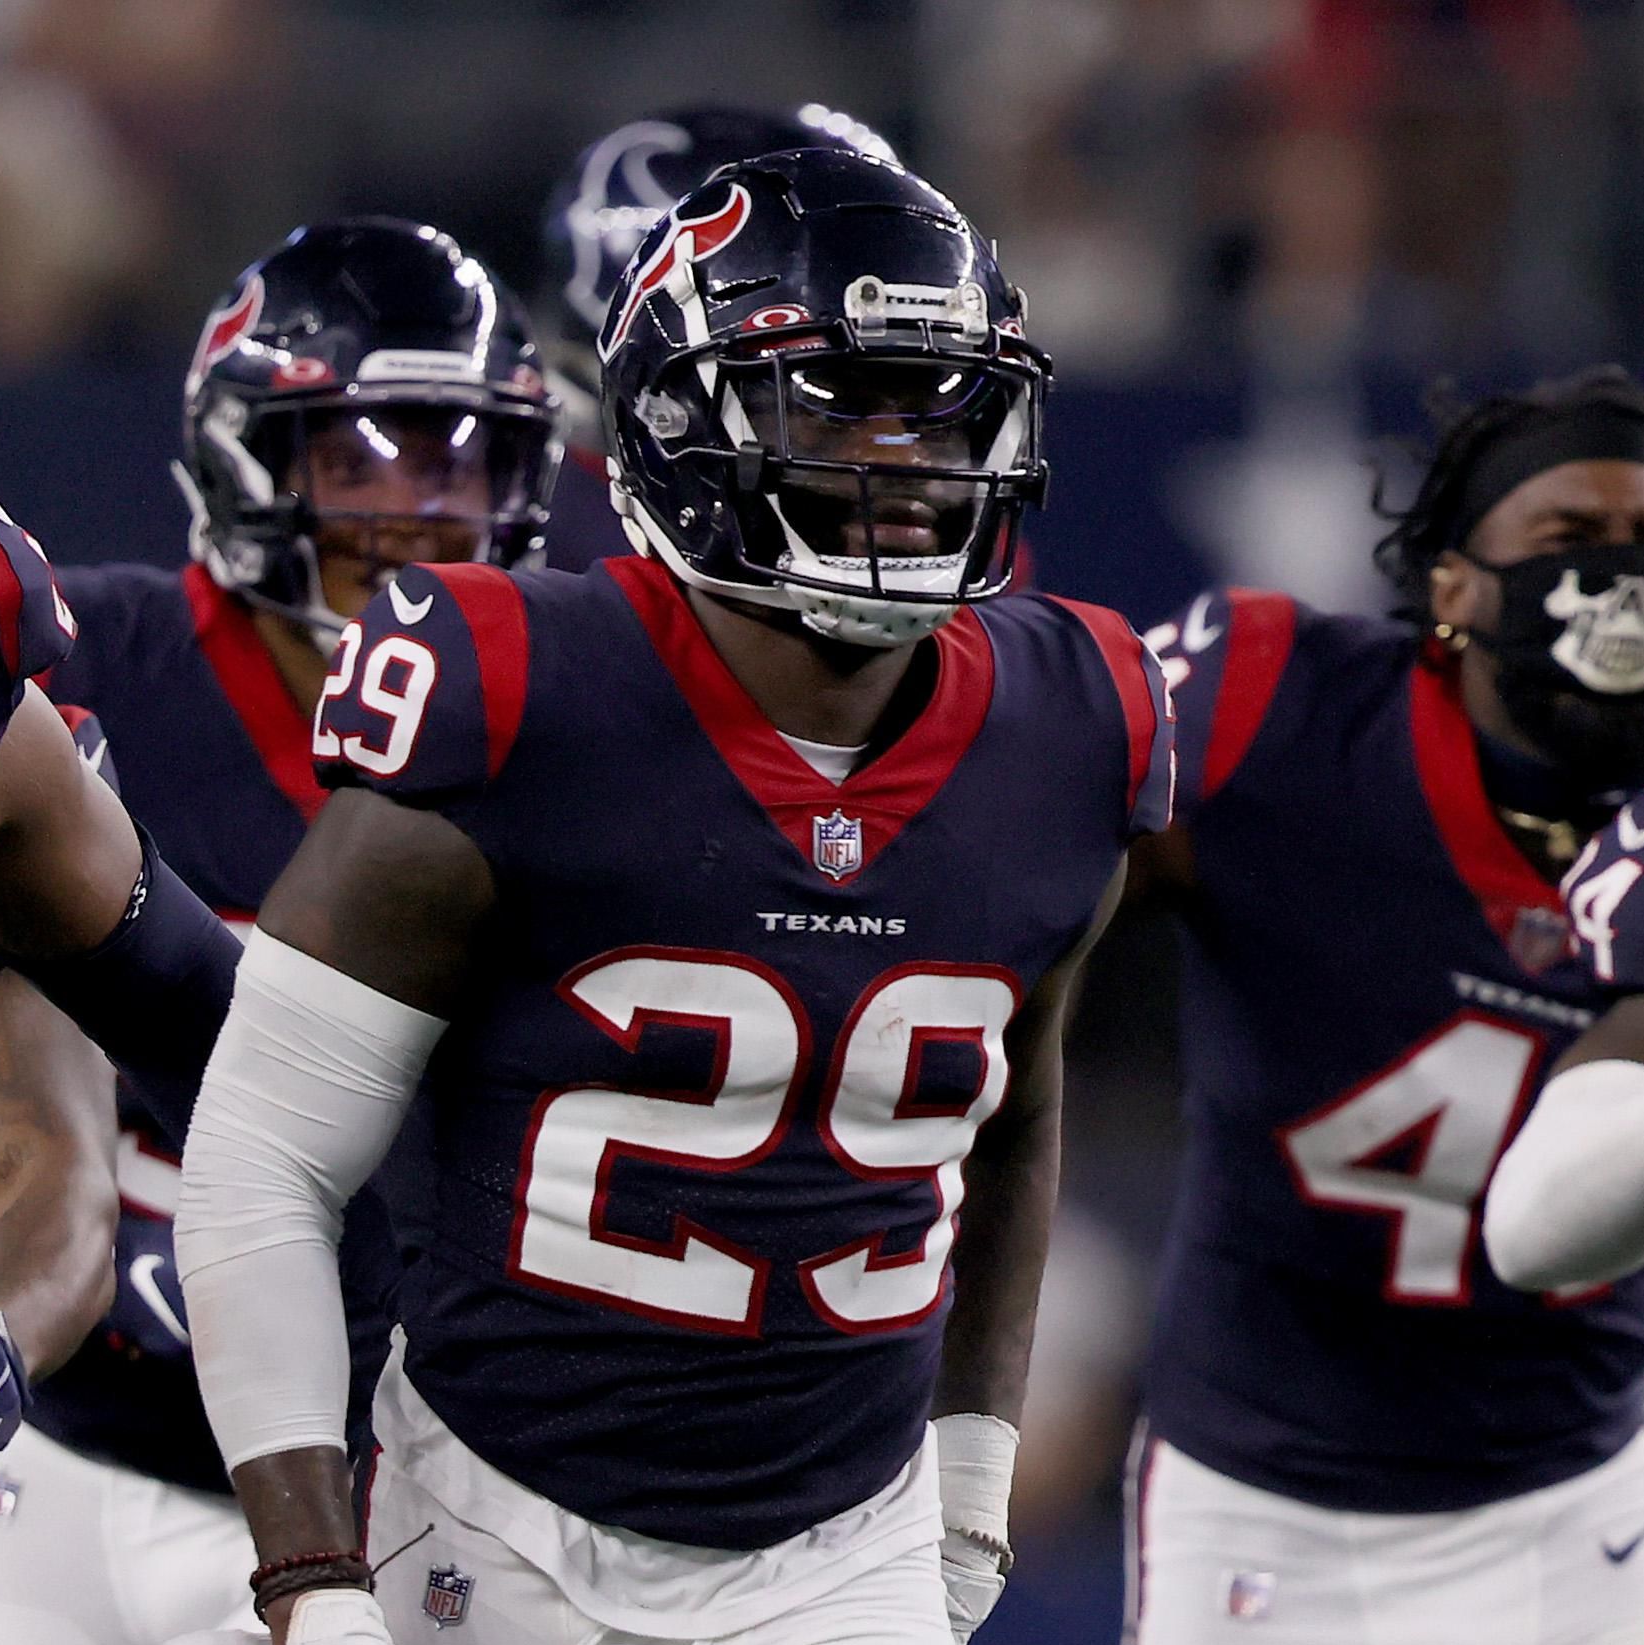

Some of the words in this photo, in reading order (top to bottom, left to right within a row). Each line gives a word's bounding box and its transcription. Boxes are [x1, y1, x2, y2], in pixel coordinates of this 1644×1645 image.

[311, 618, 443, 780] 29
[822, 842, 856, 867] NFL
[756, 912, 907, 936] TEXANS
[507, 944, 1022, 1338] 29
[427, 1588, 461, 1618] NFL
